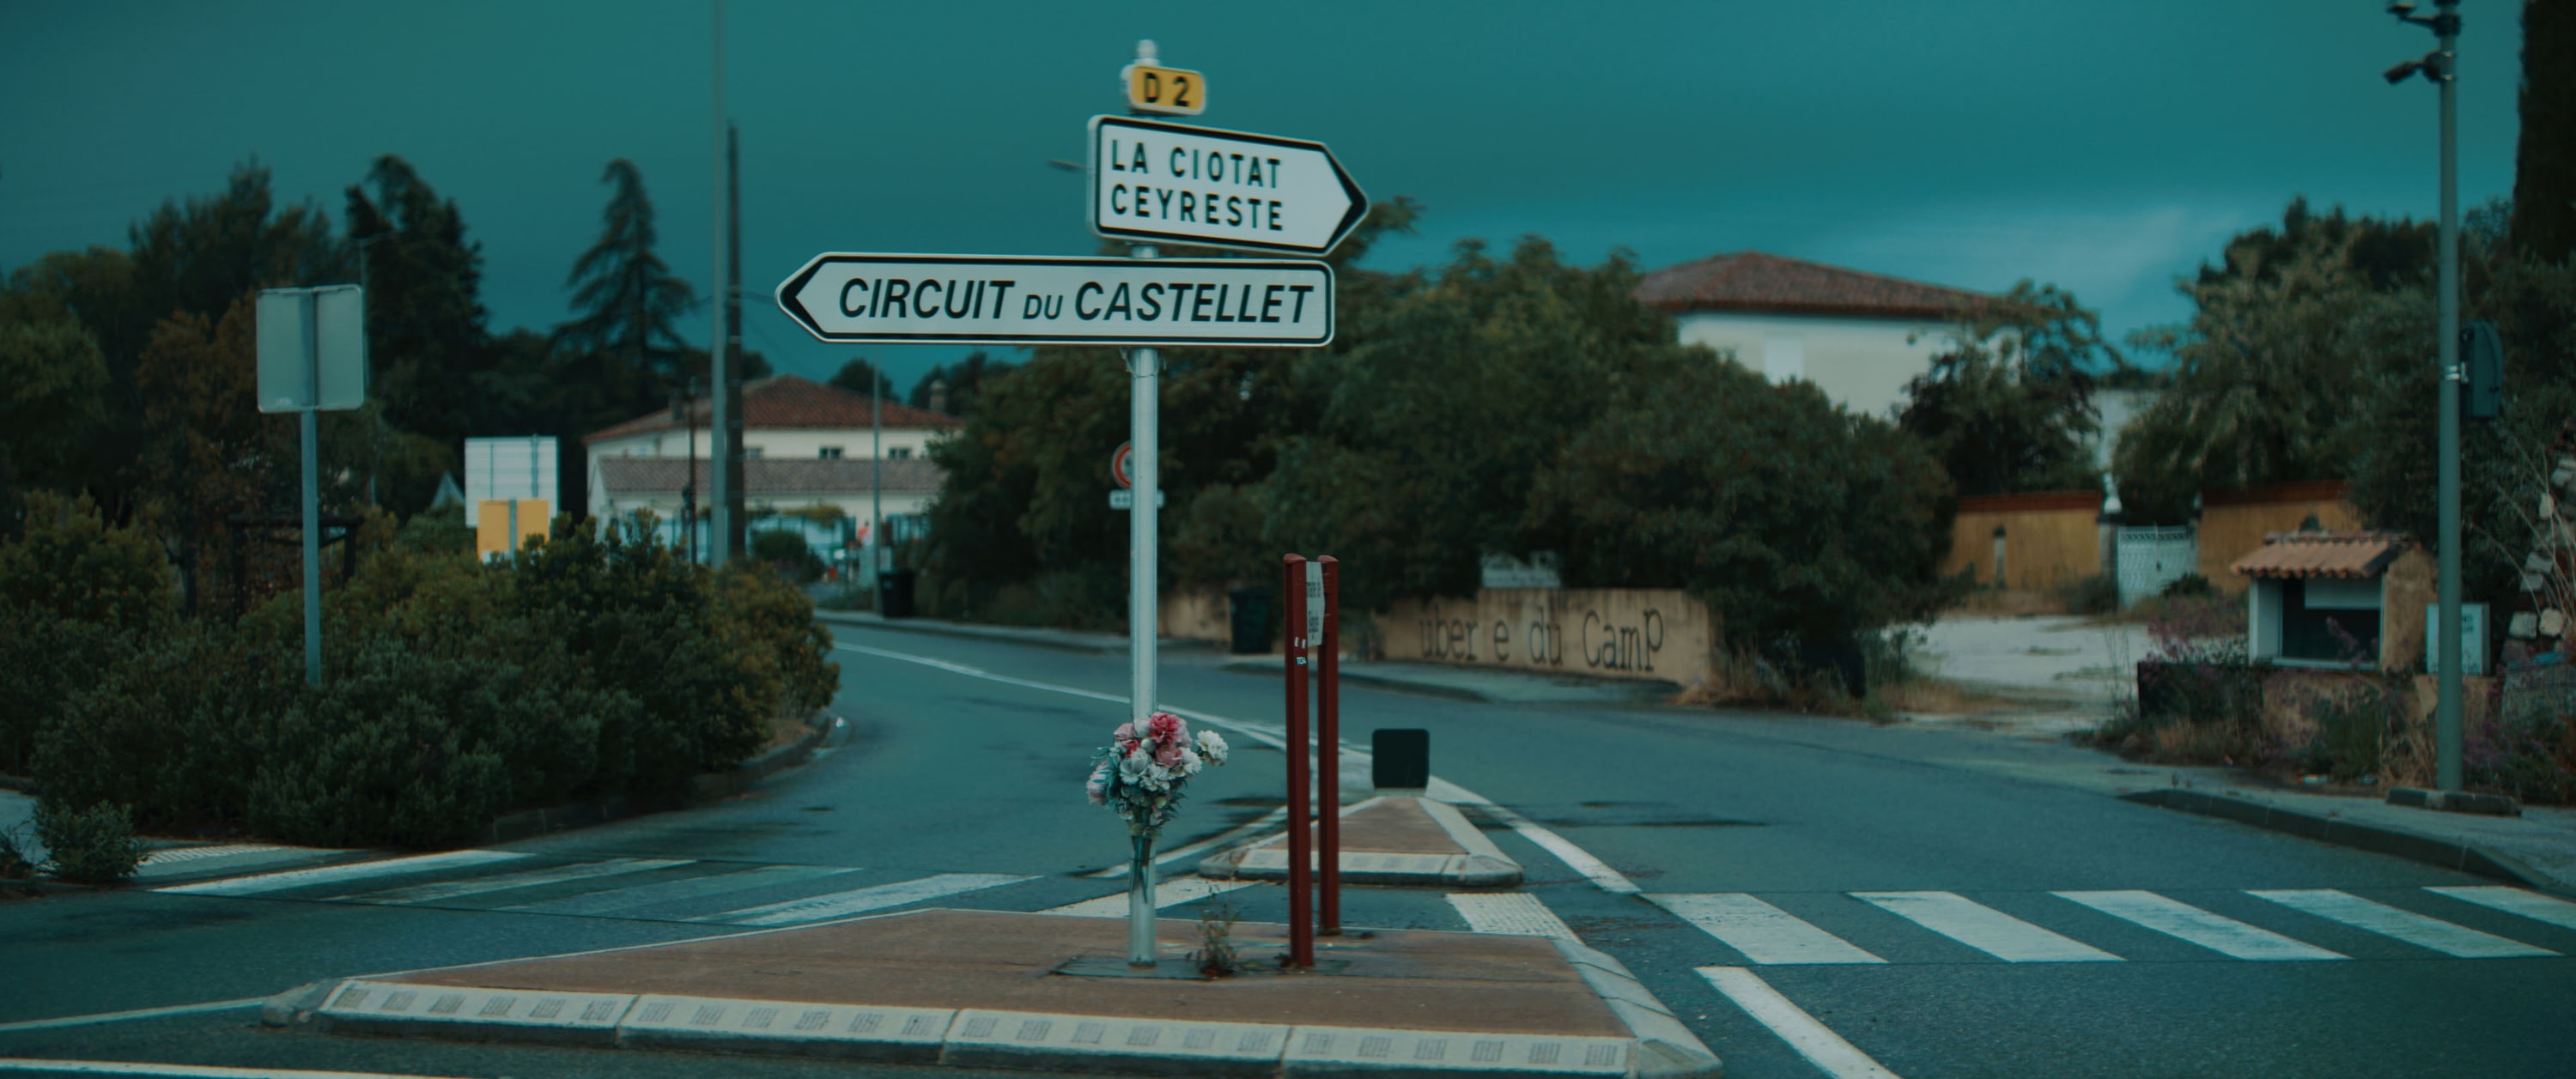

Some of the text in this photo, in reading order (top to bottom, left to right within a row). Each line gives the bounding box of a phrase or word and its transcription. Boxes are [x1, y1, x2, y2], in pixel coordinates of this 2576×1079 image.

[1144, 72, 1189, 107] D 2
[1112, 139, 1281, 189] LA CIOTAT
[1111, 183, 1283, 232] CEYRESTE
[839, 277, 1315, 324] CIRCUIT DU CASTELLET
[1528, 606, 1563, 666] du
